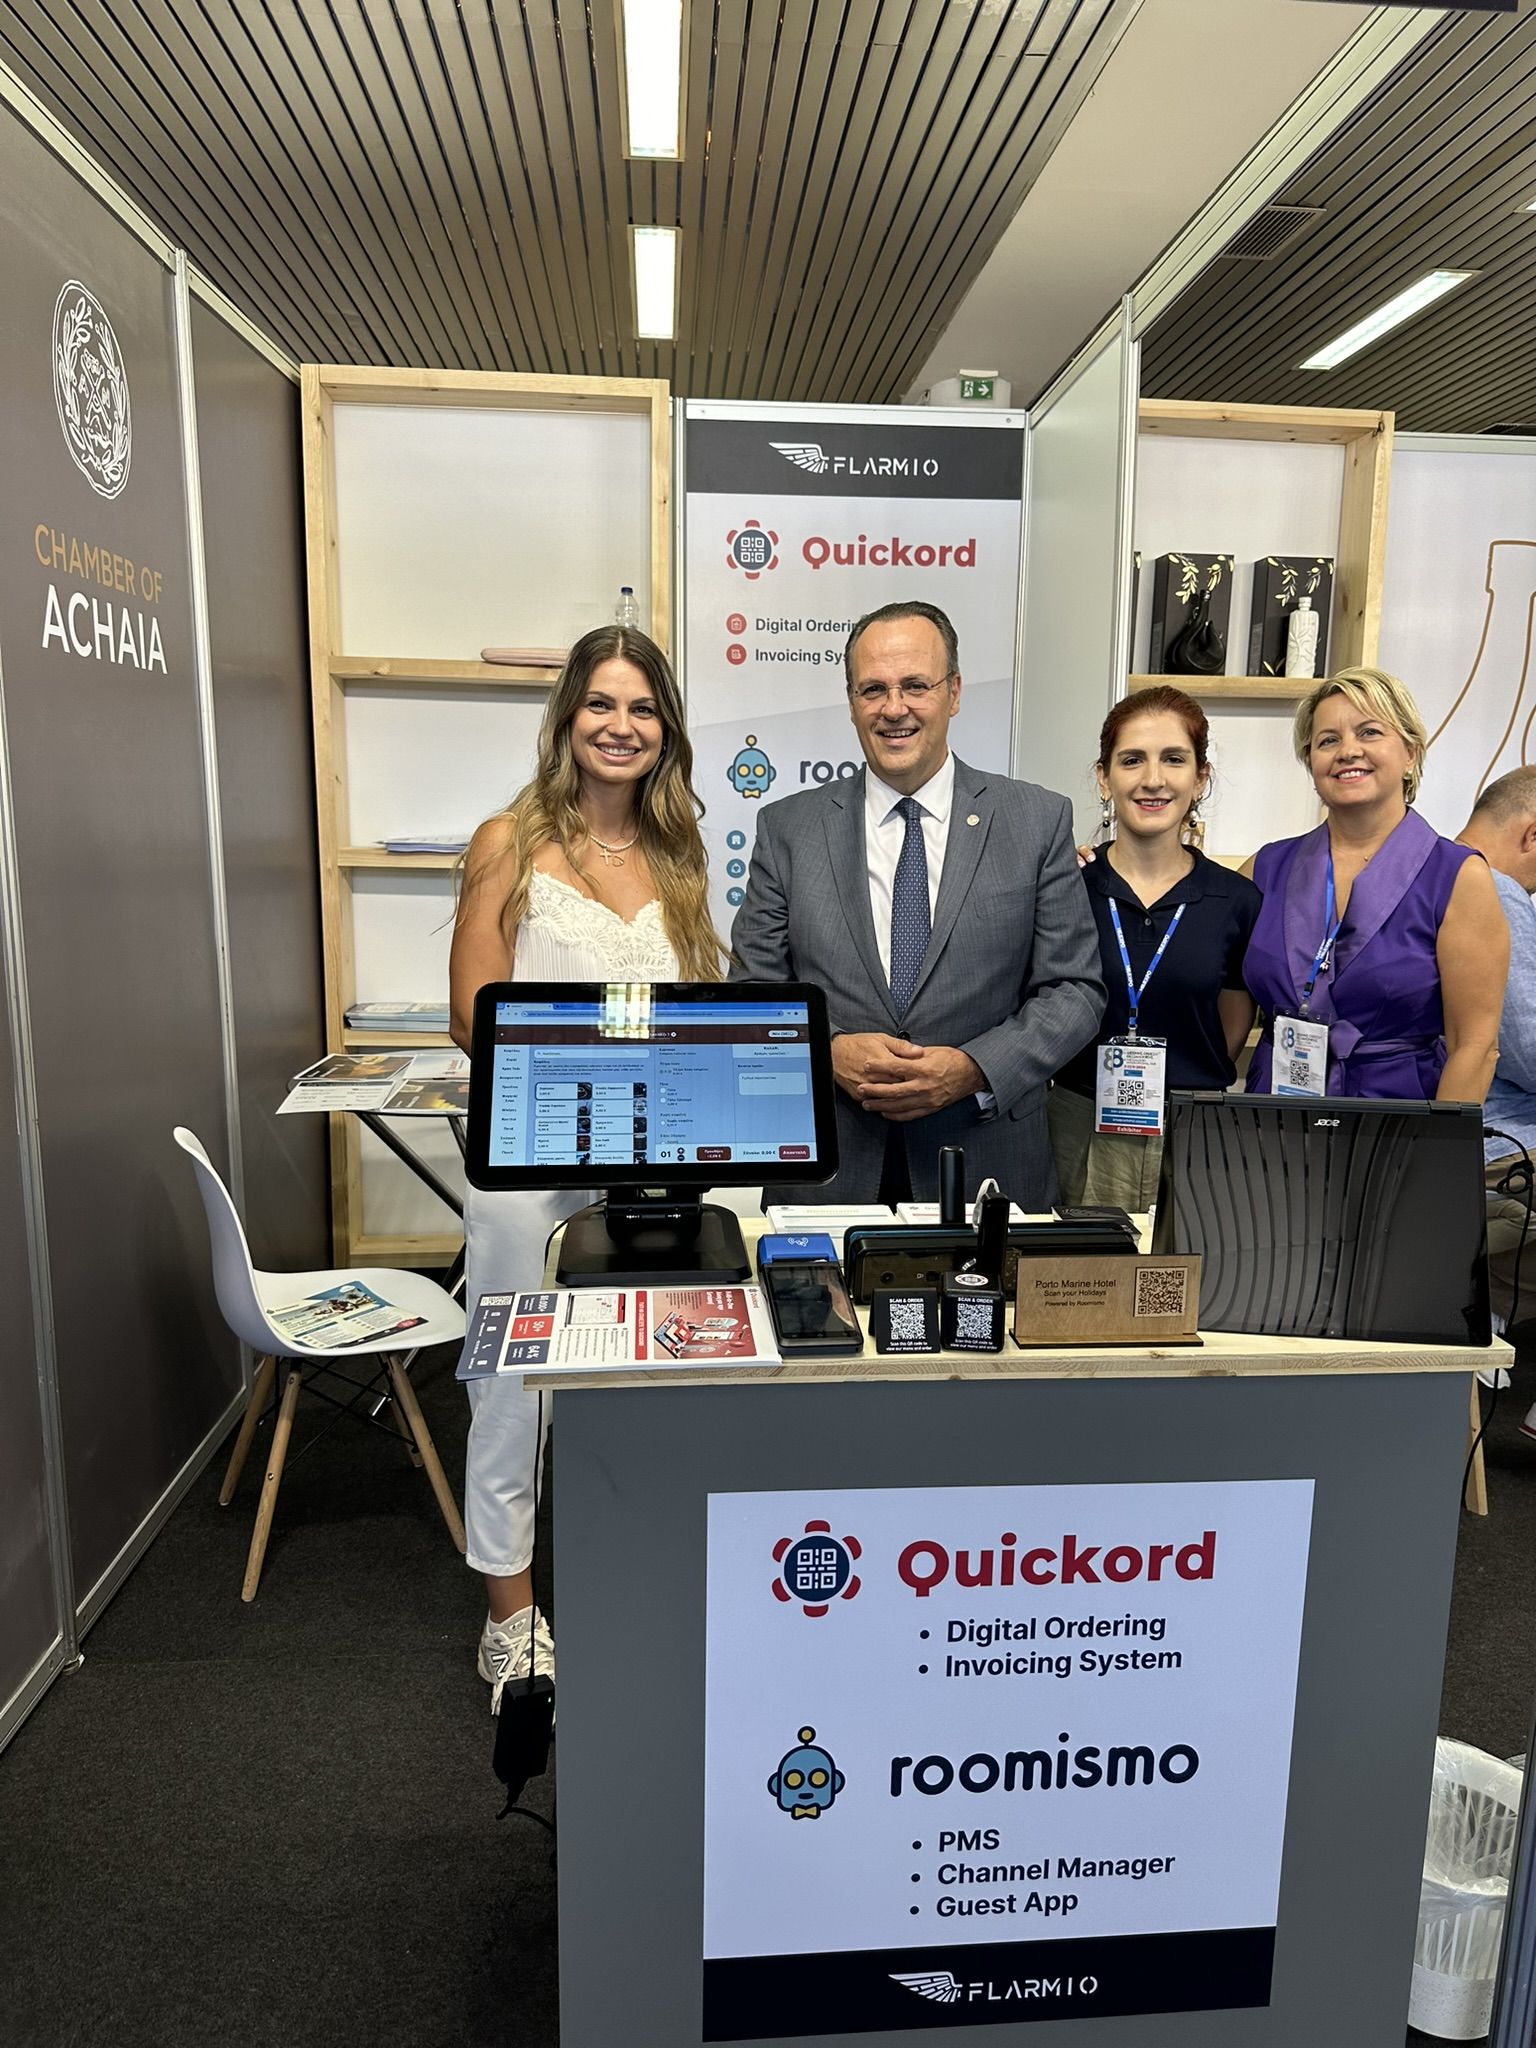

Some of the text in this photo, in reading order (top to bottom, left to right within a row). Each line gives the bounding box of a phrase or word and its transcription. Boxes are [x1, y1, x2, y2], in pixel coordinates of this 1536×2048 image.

[834, 456, 939, 476] FLARMIO
[35, 523, 163, 604] CHAMBER OF
[802, 534, 977, 570] Quickord
[42, 583, 169, 675] ACHAIA
[756, 618, 802, 634] Digital
[756, 649, 821, 665] Invoicing
[1314, 1118, 1340, 1127] acer
[660, 1150, 671, 1158] 01
[1035, 1279, 1116, 1288] Porto Marine Hotel
[897, 1530, 1217, 1598] Quickord
[947, 1613, 1166, 1648] Digital Ordering
[945, 1649, 1182, 1679] Invoicing System
[890, 1732, 1200, 1798] roomismo
[938, 1829, 1000, 1853] PMS
[937, 1856, 1176, 1885] Channel Manager
[936, 1891, 1079, 1918] Guest App
[968, 1975, 1098, 2002] FLARMIO
